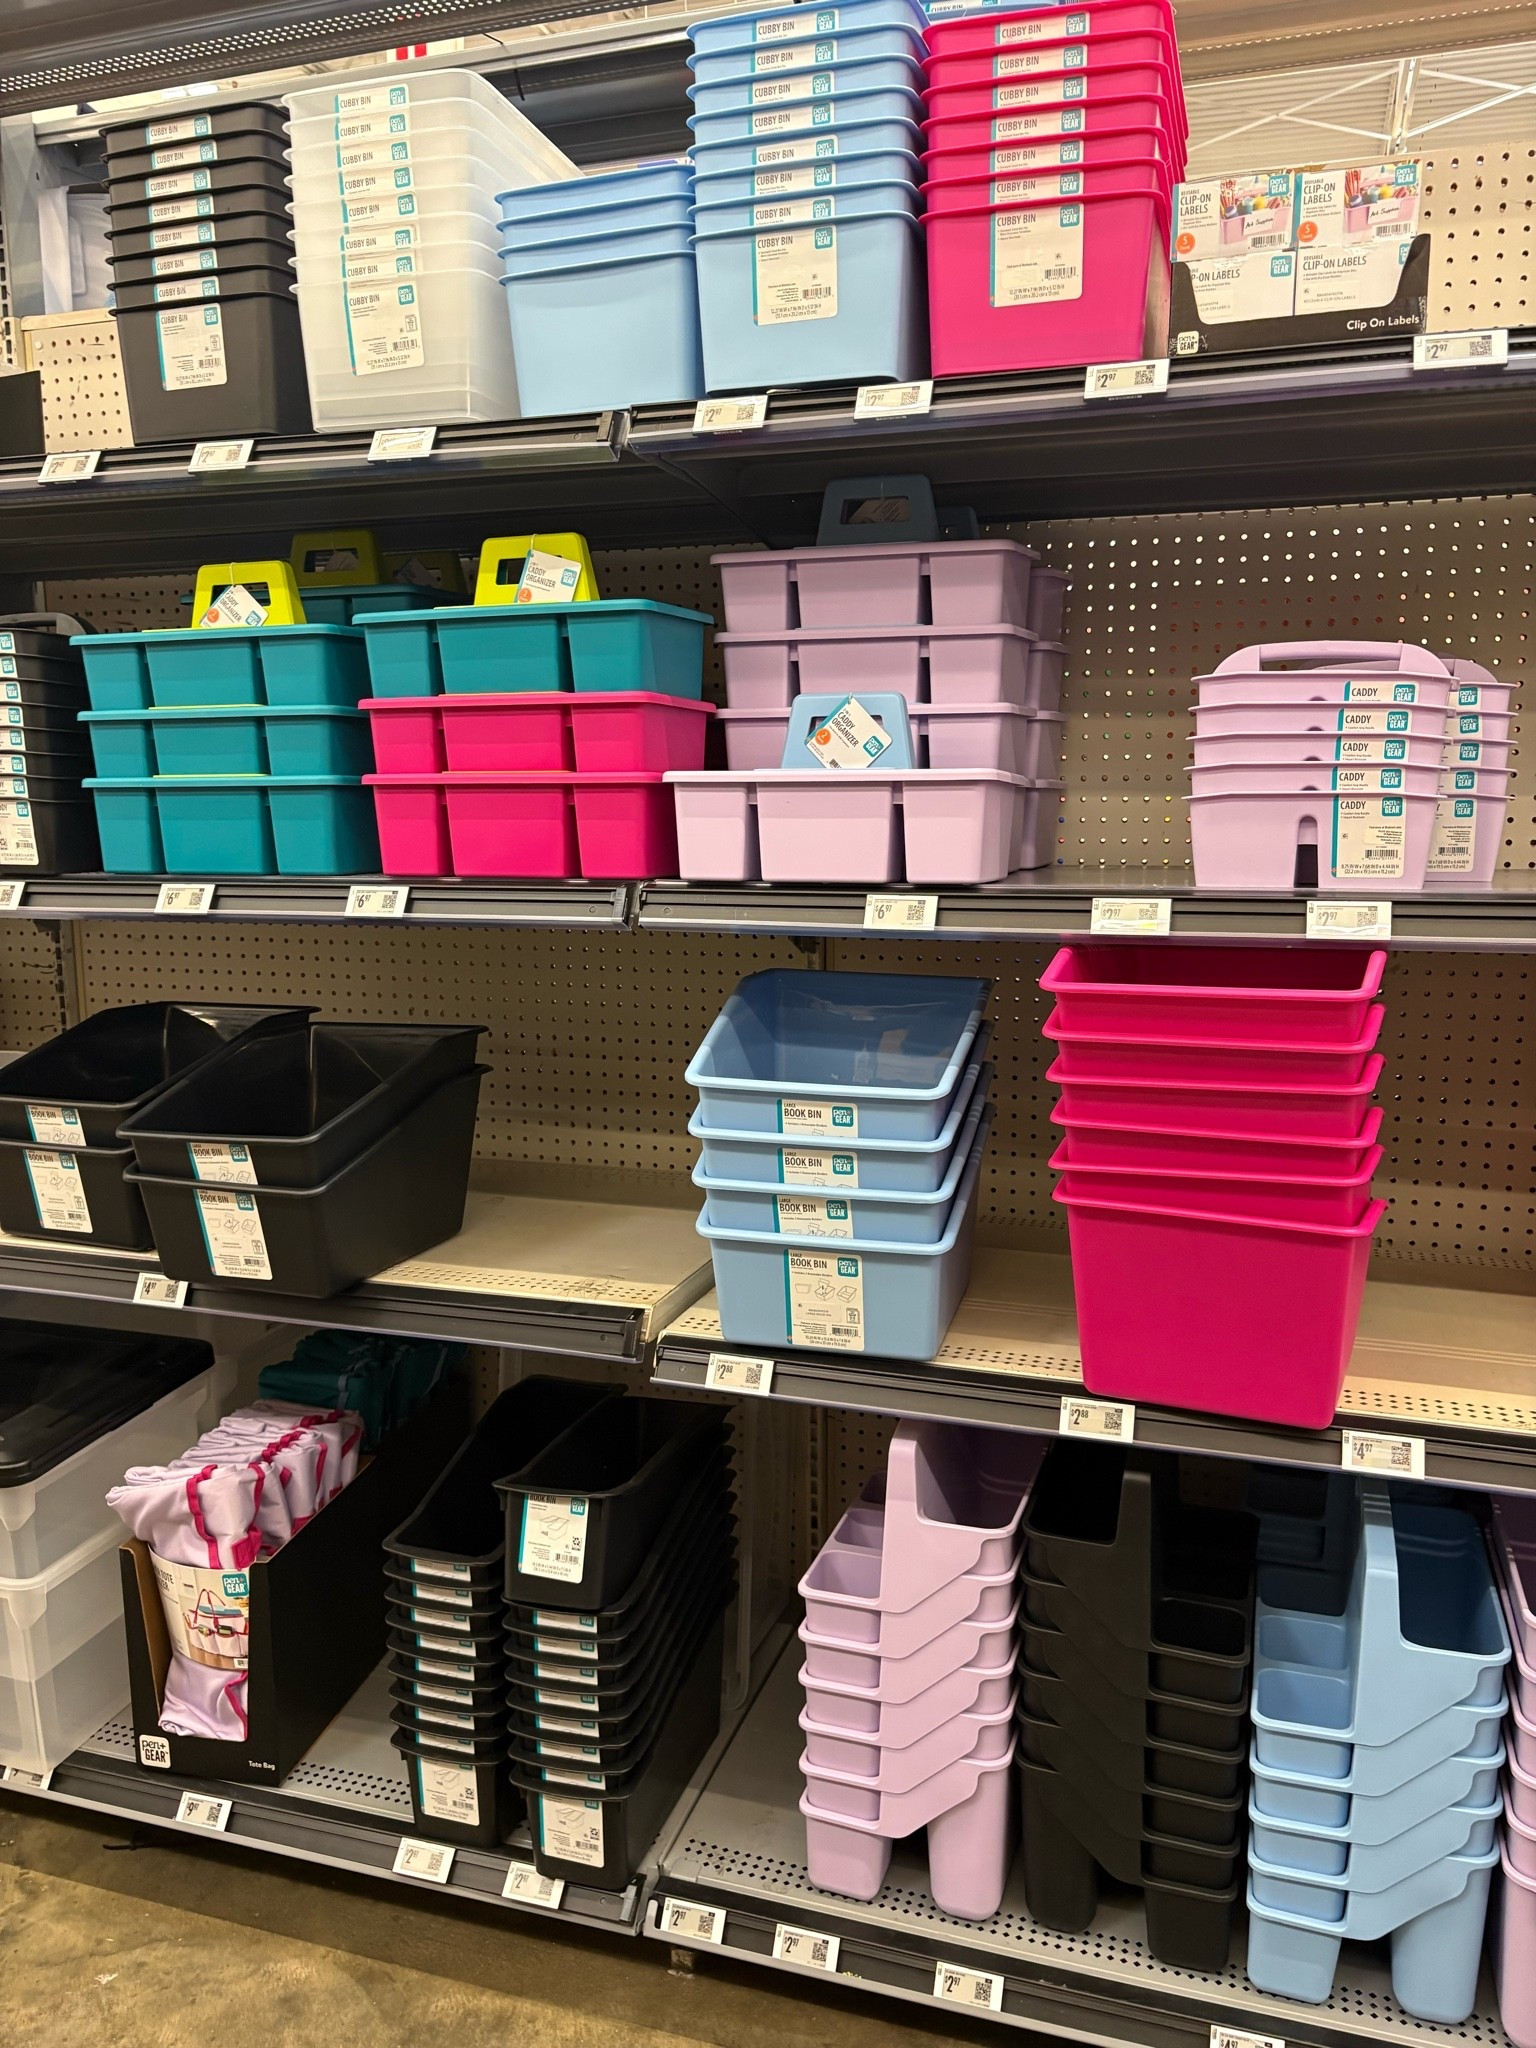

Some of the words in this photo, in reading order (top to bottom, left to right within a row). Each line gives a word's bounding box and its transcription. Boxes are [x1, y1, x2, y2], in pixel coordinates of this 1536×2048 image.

[758, 23, 781, 35] CUBBY
[783, 21, 794, 31] BIN
[818, 20, 832, 30] GEAR
[1069, 23, 1083, 33] GEAR
[1002, 26, 1027, 38] CUBBY
[1028, 24, 1041, 34] BIN
[757, 55, 779, 65] CUBBY
[781, 52, 793, 62] BIN
[818, 51, 831, 60] GEAR
[1066, 55, 1080, 65] GEAR
[1000, 58, 1024, 69] CUBBY
[1026, 56, 1039, 66] BIN
[999, 89, 1024, 100] CUBBY
[1026, 87, 1038, 96] BIN
[1065, 86, 1080, 96] GEAR
[340, 98, 359, 108] CUBBY
[361, 96, 371, 105] BIN
[755, 116, 777, 127] CUBBY
[778, 114, 790, 123] BIN
[998, 121, 1022, 132] CUBBY
[1024, 119, 1037, 128] BIN
[1064, 119, 1078, 128] GEAR
[151, 127, 168, 136] CUBBY
[169, 125, 178, 133] BIN
[345, 179, 364, 189] CUBBY
[365, 177, 375, 186] BIN
[756, 174, 779, 185] CUBBY
[780, 172, 792, 182] BIN
[817, 174, 830, 183] GEAR
[1398, 174, 1413, 183] GEAR
[151, 181, 167, 191] CUBBY
[168, 179, 177, 188] BIN
[997, 182, 1021, 193] CUBBY
[1023, 180, 1036, 190] BIN
[1062, 181, 1077, 191] GEAR
[1272, 184, 1287, 193] GEAR
[1304, 183, 1335, 194] CLIP-ON
[1181, 194, 1211, 205] CLIP-ON
[1304, 193, 1332, 205] LABELS
[349, 206, 367, 217] CUBBY
[369, 204, 379, 213] BIN
[1181, 204, 1208, 216] LABELS
[997, 215, 1021, 226] CUBBY
[1023, 213, 1036, 223] BIN
[1062, 213, 1077, 223] GEAR
[1306, 225, 1310, 233] 5
[346, 239, 364, 249] CUBBY
[366, 238, 376, 246] BIN
[758, 237, 779, 248] CUBBY
[781, 236, 793, 246] BIN
[818, 236, 831, 245] GEAR
[1183, 236, 1187, 245] 5
[1303, 260, 1335, 270] CLIP-ON
[1338, 256, 1366, 267] LABELS
[1212, 269, 1240, 280] LABELS
[1274, 266, 1289, 274] GEAR
[349, 297, 368, 307] CUBBY
[369, 294, 380, 303] BIN
[161, 316, 177, 324] CUBBY
[179, 314, 188, 322] BIN
[1347, 321, 1367, 331] Clip
[1370, 318, 1384, 327] On
[1389, 315, 1419, 326] Labels
[1180, 341, 1198, 350] GEAR
[528, 566, 546, 576] CADDY
[526, 574, 556, 588] ORGANIZER
[225, 593, 239, 607] CADDY
[220, 598, 242, 622] ORGANIZER
[1352, 688, 1378, 696] CADDY
[1396, 693, 1412, 701] GEAR
[838, 712, 856, 729] CADDY
[1345, 715, 1371, 723] CADDY
[1390, 720, 1405, 728] GEAR
[832, 718, 859, 747] ORGANIZER
[1343, 743, 1368, 751] CADDY
[1339, 773, 1365, 781] CADDY
[1340, 801, 1366, 809] CADDY
[1384, 806, 1399, 814] GEAR
[784, 1108, 806, 1117] BOOK
[808, 1110, 821, 1118] BIN
[785, 1158, 806, 1166] BOOK
[809, 1159, 822, 1167] BIN
[218, 1195, 229, 1203] BIN
[780, 1204, 800, 1212] BOOK
[791, 1258, 812, 1267] BOOK
[814, 1260, 827, 1268] BIN
[841, 1266, 855, 1274] GEAR
[227, 1584, 245, 1593] GEAR
[145, 1749, 166, 1762] GEAR
